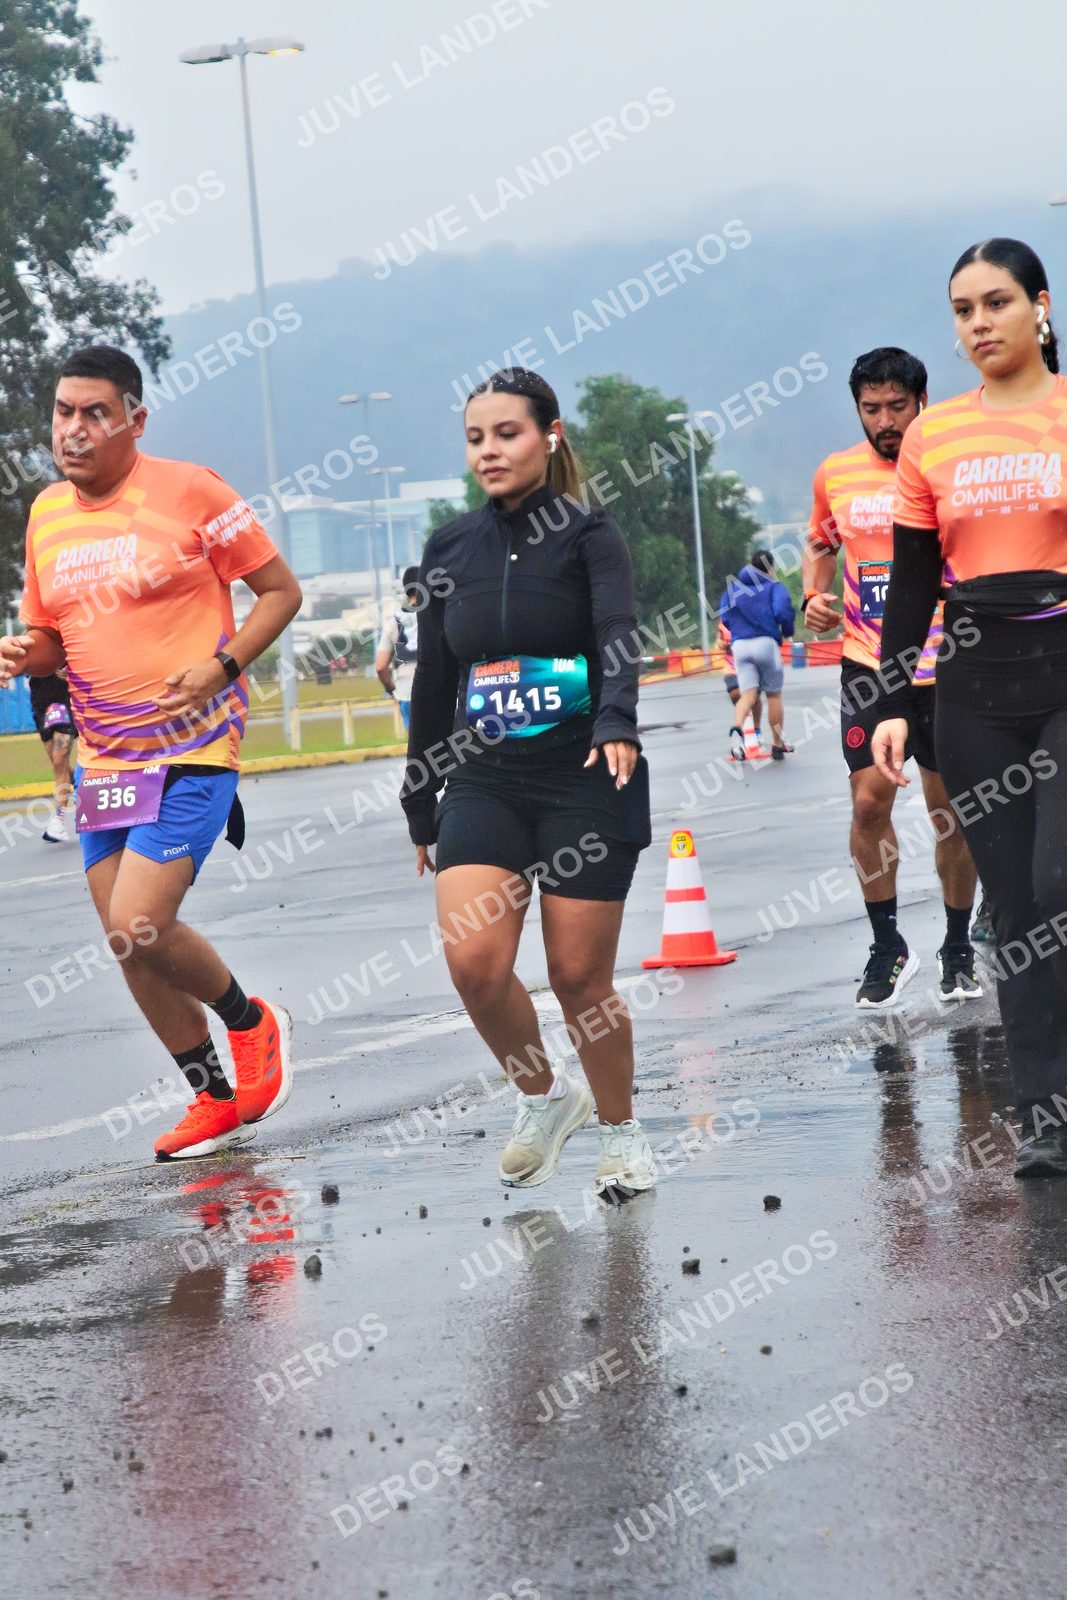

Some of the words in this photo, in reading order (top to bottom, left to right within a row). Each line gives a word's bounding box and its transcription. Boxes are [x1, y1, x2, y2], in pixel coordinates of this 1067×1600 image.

[953, 453, 1062, 487] CARRERA
[952, 482, 1036, 506] OMNILIFE
[55, 533, 137, 573] CARRERA
[52, 562, 116, 590] OMNILIFE
[474, 674, 509, 687] OMNILIFE
[475, 659, 520, 678] CARRERA
[489, 686, 562, 714] 1415
[83, 777, 110, 787] OMNILIFE
[97, 785, 136, 811] 336
[163, 843, 190, 857] FIGHT
